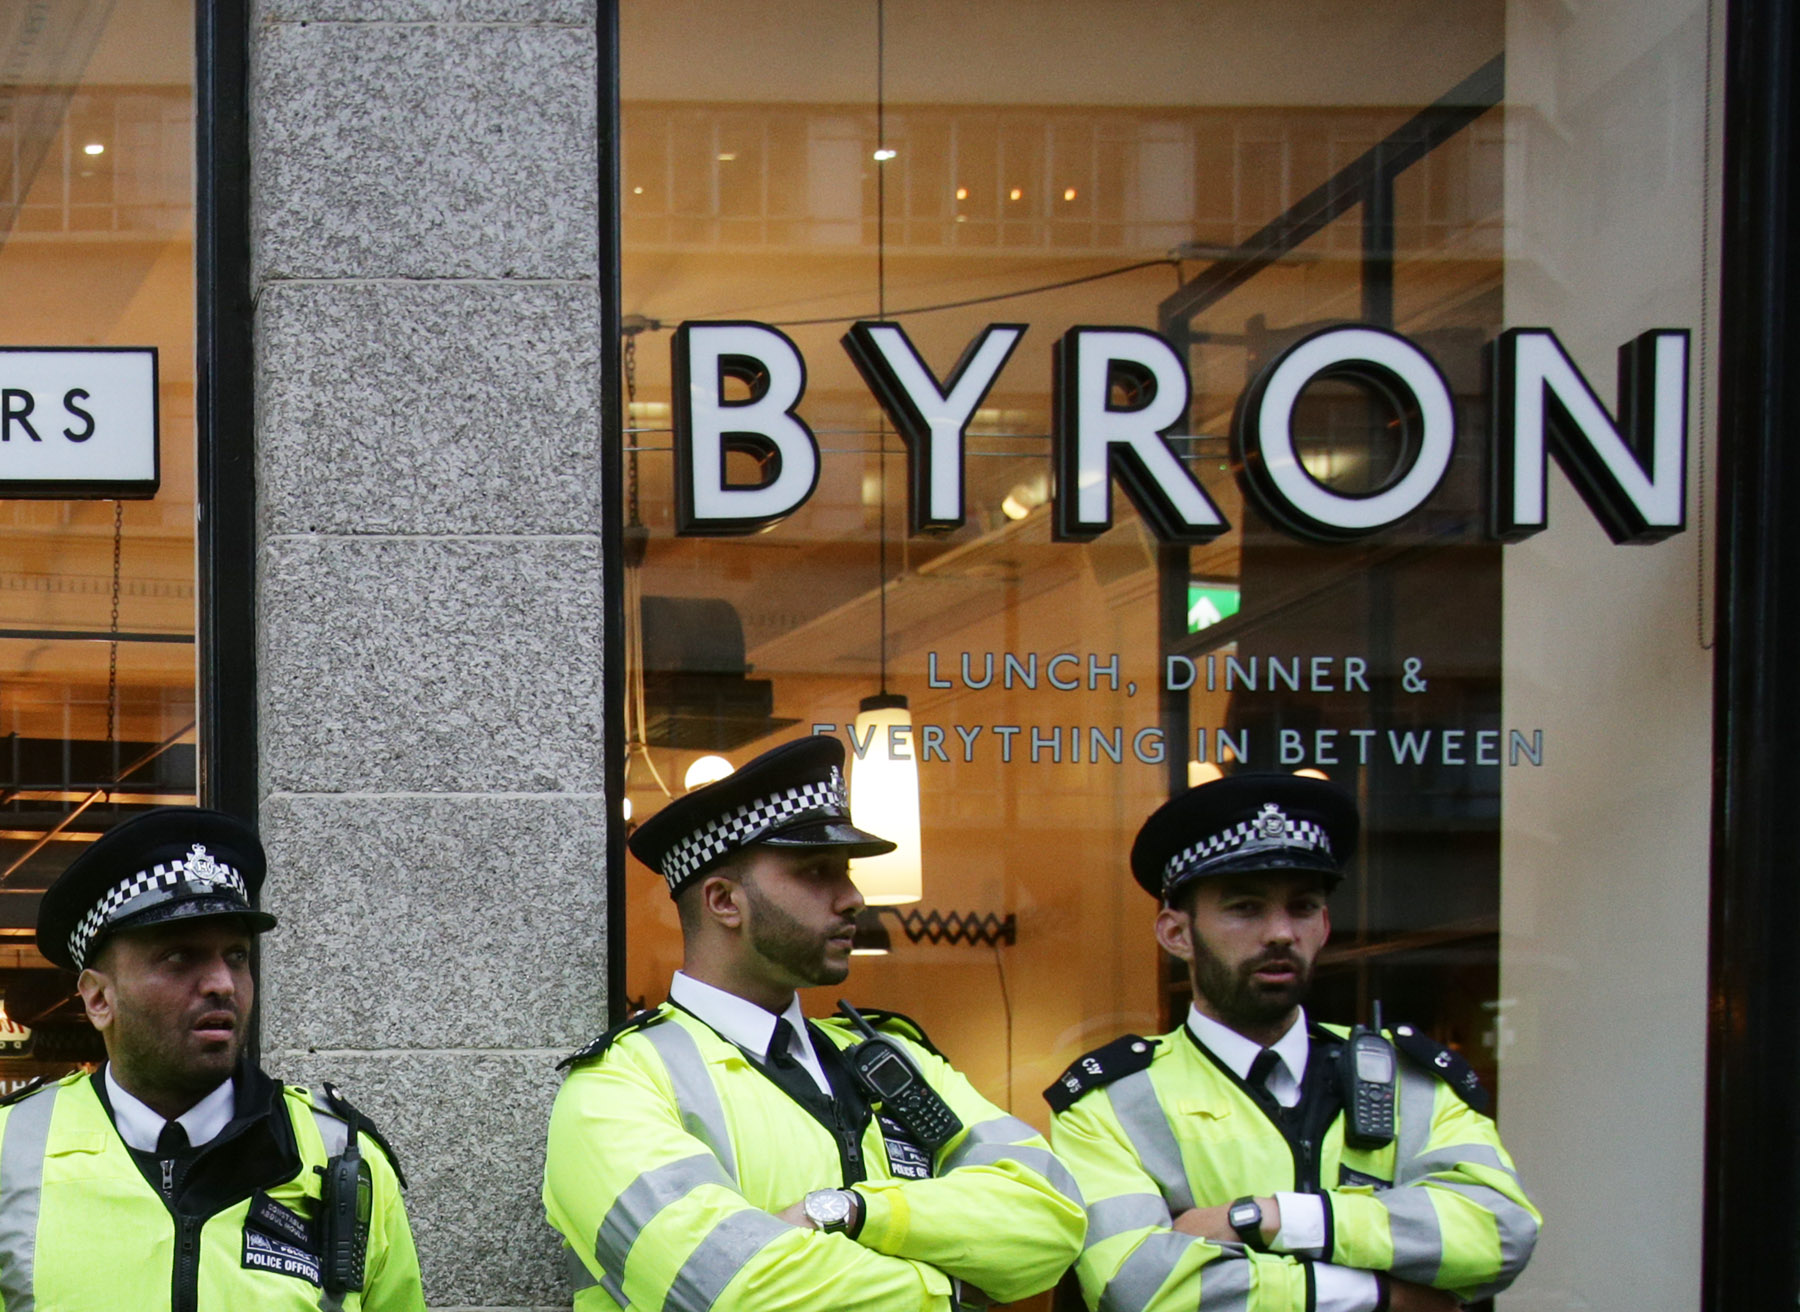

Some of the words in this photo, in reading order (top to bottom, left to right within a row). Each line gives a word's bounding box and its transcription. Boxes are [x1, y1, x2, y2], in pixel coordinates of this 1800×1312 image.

[674, 320, 1691, 543] BYRON
[928, 652, 1137, 697] LUNCH,
[1166, 655, 1370, 692] DINNER
[1401, 657, 1429, 694] &
[1198, 727, 1249, 765] IN
[1280, 728, 1544, 766] BETWEEN
[246, 1252, 282, 1269] POLICE
[284, 1260, 319, 1283] OFFICER
